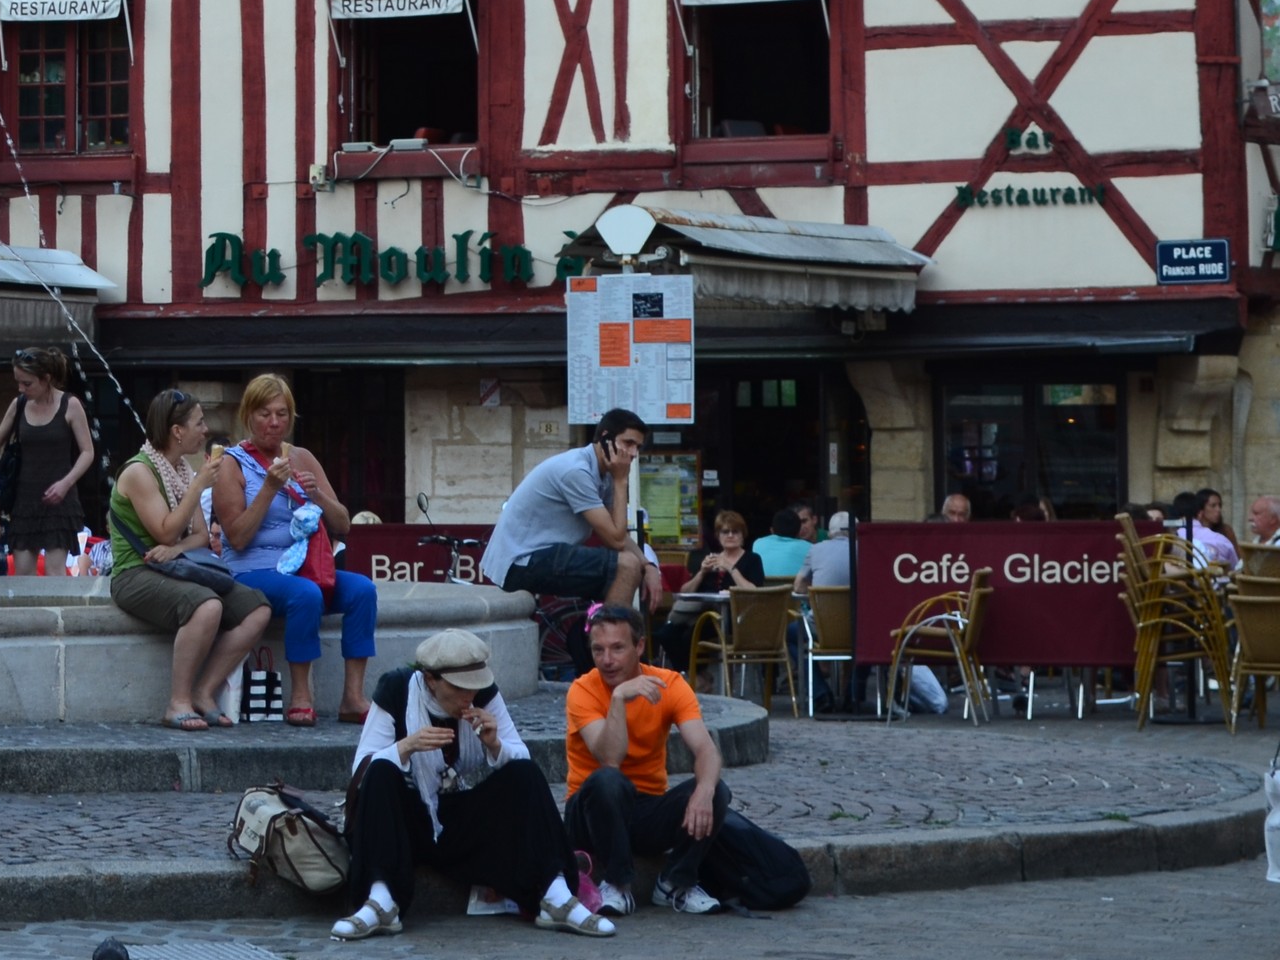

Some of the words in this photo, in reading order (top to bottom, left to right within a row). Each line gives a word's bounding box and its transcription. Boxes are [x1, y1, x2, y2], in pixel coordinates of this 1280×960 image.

[9, 0, 110, 16] RESTAURANT
[1007, 128, 1055, 150] Bar
[956, 185, 1105, 208] Restaurant
[199, 232, 287, 289] Au
[303, 230, 534, 287] Moulin
[1173, 246, 1213, 259] PLACE
[1199, 263, 1224, 275] RUDE
[545, 423, 552, 433] 8
[371, 555, 424, 582] Bar
[893, 553, 970, 583] Café
[1004, 553, 1125, 583] Glacier
